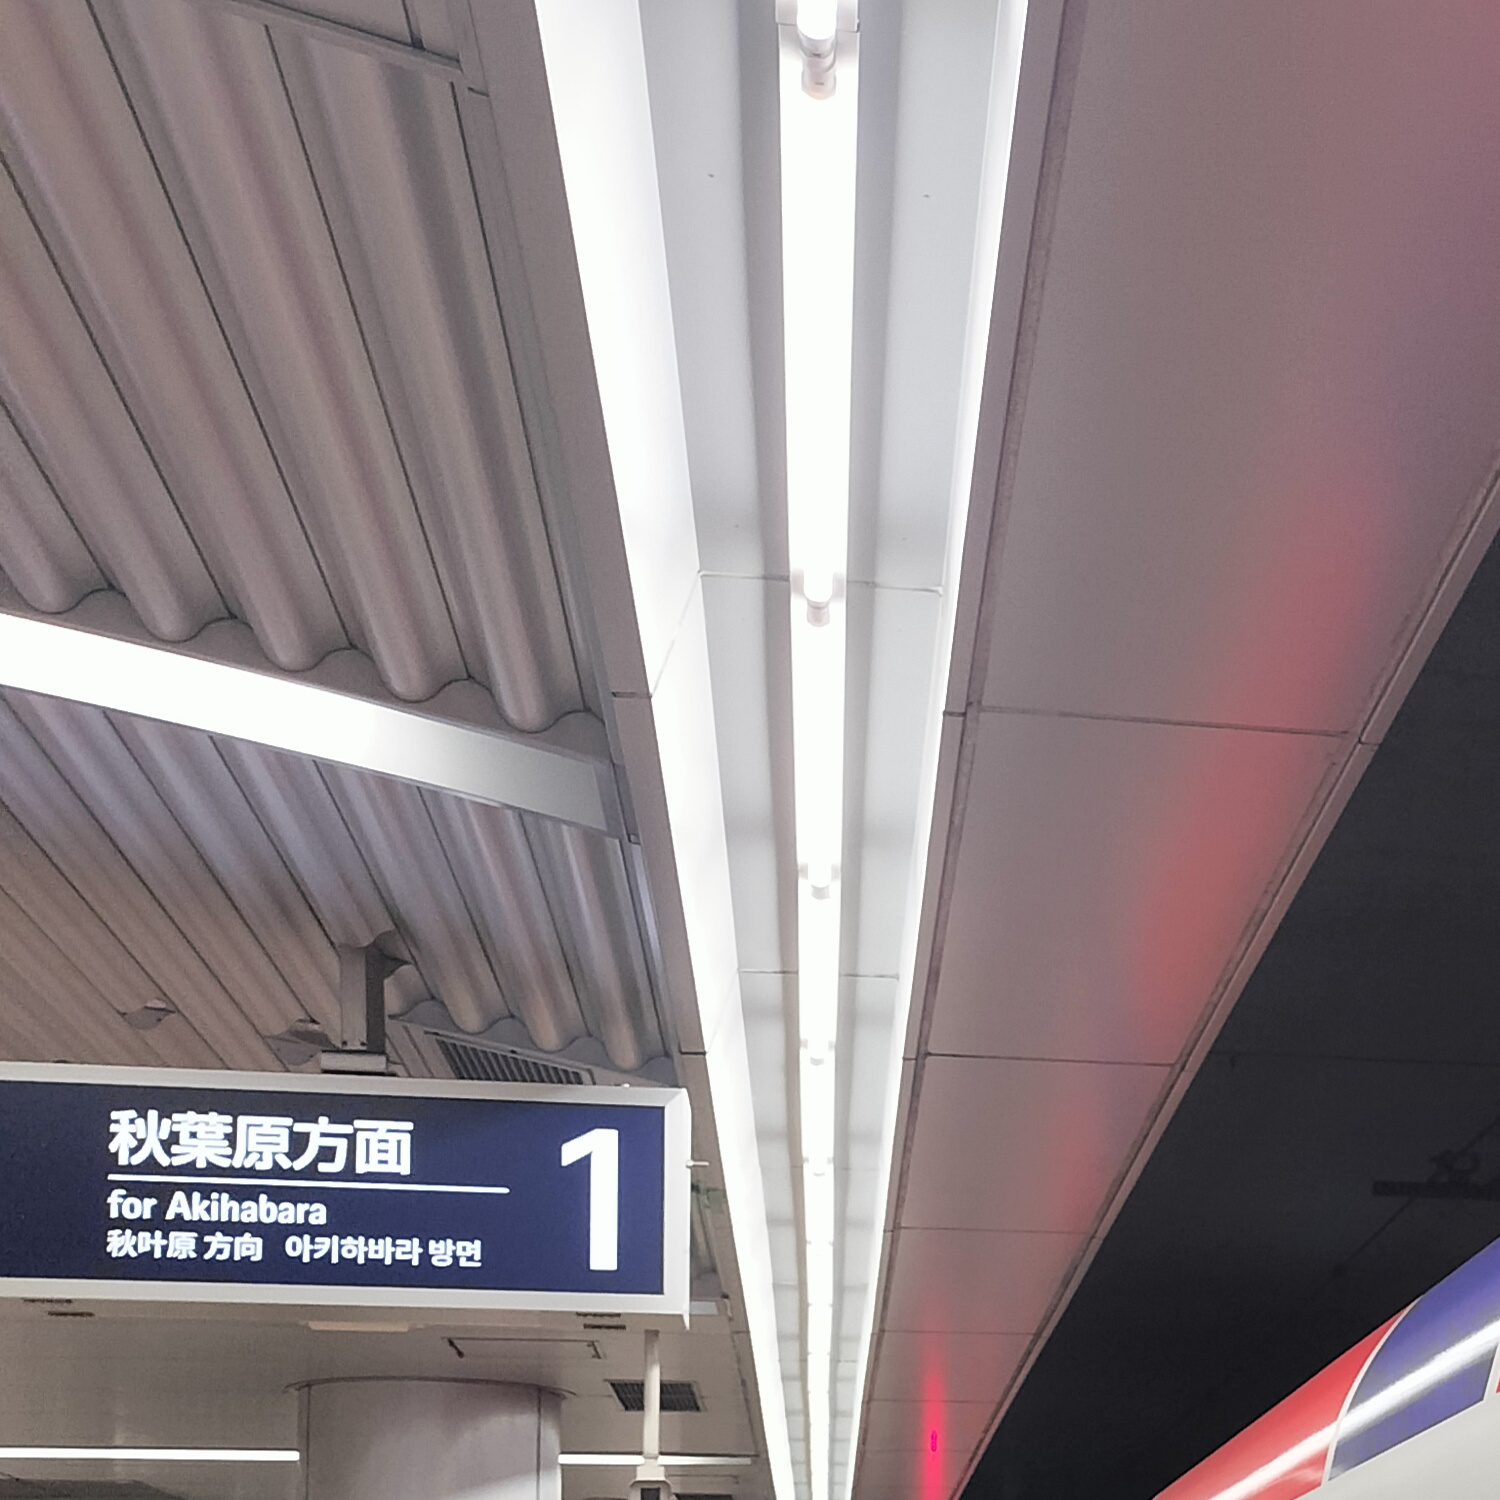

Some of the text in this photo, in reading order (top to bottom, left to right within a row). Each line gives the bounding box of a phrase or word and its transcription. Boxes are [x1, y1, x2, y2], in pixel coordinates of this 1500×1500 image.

[107, 1108, 415, 1176] 秋葉原方面
[106, 1189, 327, 1225] for Akihabara
[560, 1127, 619, 1271] 1
[106, 1228, 264, 1262] 秋叶原 方向
[285, 1233, 483, 1269] 아키하바라 방면
